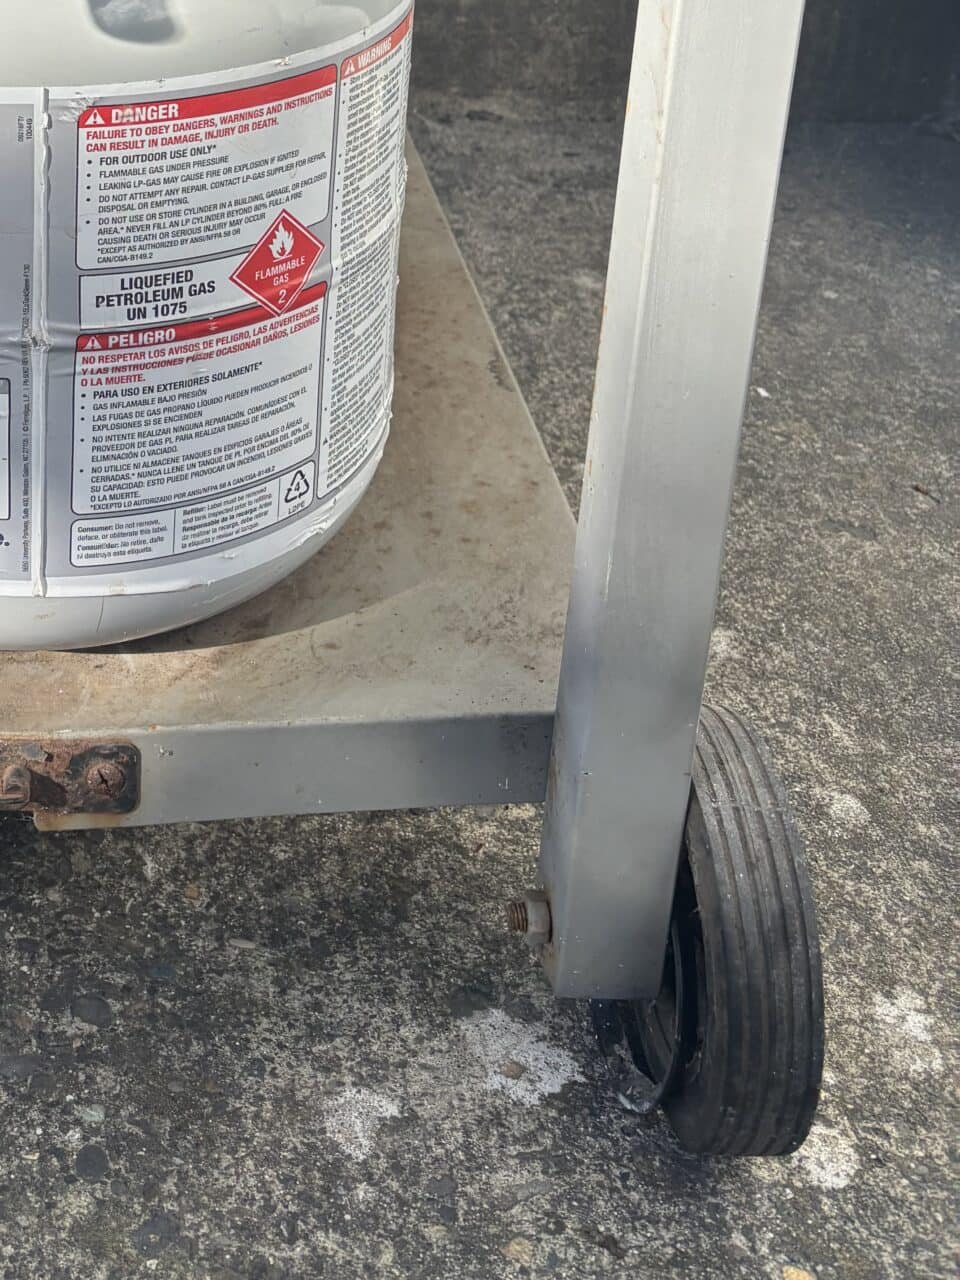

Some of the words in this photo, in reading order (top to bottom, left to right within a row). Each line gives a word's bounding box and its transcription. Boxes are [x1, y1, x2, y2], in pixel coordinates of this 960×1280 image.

[357, 38, 392, 69] WARNING
[86, 129, 127, 140] FAILURE
[131, 128, 142, 137] TO
[145, 125, 169, 135] OBEY
[173, 118, 217, 132] DANGERS,
[220, 109, 264, 125] WARNINGS
[266, 104, 282, 115] AND
[284, 88, 332, 111] INSTRUCTIONS
[112, 104, 178, 123] DANGER
[86, 143, 106, 152] CAN
[110, 140, 145, 151] RESULT
[148, 138, 158, 147] IN
[161, 133, 202, 146] DAMAGE,
[205, 127, 235, 140] INJURY
[238, 124, 249, 134] OR
[252, 117, 279, 131] DEATH.
[100, 156, 119, 166] FOR
[122, 152, 167, 164] OUTDOOR
[170, 150, 187, 160] USE
[100, 167, 146, 178] FLAMMABLE
[149, 165, 164, 175] GAS
[166, 162, 190, 172] UNDER
[193, 156, 229, 168] PRESSURE
[99, 180, 131, 190] LEAKING
[134, 177, 161, 188] LP-GAS
[163, 176, 179, 185] MAY
[181, 172, 204, 182] CAUSE
[206, 169, 221, 178] FIRE
[223, 167, 232, 175] OR
[234, 159, 268, 173] EXPLOSION
[112, 194, 127, 202] NOT
[129, 190, 162, 200] ATTEMPT
[165, 188, 180, 196] ANY
[182, 184, 208, 194] REPAIR.
[210, 177, 240, 189] CONTACT
[242, 172, 265, 183] LP-GAS
[266, 163, 294, 176] SUPPLIER
[295, 159, 306, 167] FOR
[98, 204, 136, 213] DISPOSAL
[138, 202, 148, 210] OR
[99, 217, 109, 225] DO
[112, 216, 127, 224] NOT
[129, 214, 144, 222] USE
[146, 213, 156, 221] OR
[159, 210, 181, 219] STORE
[184, 204, 217, 216] CYLINDER
[220, 202, 226, 210] IN
[292, 183, 300, 191] OR
[126, 224, 150, 233] NEVER
[153, 221, 166, 230] FILL
[169, 219, 179, 227] AN
[181, 218, 190, 226] LP
[192, 212, 225, 224] CYLINDER
[227, 206, 252, 217] BEYOND
[98, 236, 131, 245] CAUSING
[133, 233, 157, 242] DEATH
[159, 231, 169, 239] OR
[171, 226, 201, 238] SERIOUS
[204, 222, 226, 232] INJURY
[229, 218, 242, 227] MAY
[138, 238, 178, 251] AUTHORIZED
[180, 237, 188, 245] BY
[256, 256, 305, 280] FLAMMABLE
[120, 270, 193, 290] LIQUEFIED
[273, 274, 288, 286] GAS
[96, 287, 183, 308] PETROLEUM
[188, 280, 215, 296] GAS
[278, 289, 286, 304] 2
[127, 307, 146, 320] UN
[152, 301, 187, 317] 1075
[82, 356, 95, 365] NO
[98, 352, 145, 364] RESPETAR
[149, 349, 165, 358] LOS
[168, 343, 200, 356] AVISOS
[203, 340, 214, 349] DE
[216, 331, 251, 346] PELIGRO,
[253, 325, 267, 337] LAS
[269, 304, 319, 331] ADVERTENCIAS
[91, 367, 108, 375] LAS
[112, 358, 184, 372] INSTRUCCIONES
[216, 340, 261, 356] OCASIONAR
[290, 314, 320, 333] LESIONES
[108, 328, 176, 348] PELIGRO
[90, 377, 102, 386] LA
[106, 374, 145, 384] MUERTE.
[93, 390, 118, 399] PARA
[121, 387, 139, 397] USO
[142, 386, 154, 394] EN
[157, 376, 209, 393] EXTERIORES
[93, 414, 106, 422] LAS
[109, 411, 133, 420] FUGAS
[135, 410, 144, 418] DE
[147, 407, 161, 416] GAS
[163, 402, 195, 413] PROPANO
[225, 389, 249, 400] PUEDEN
[110, 397, 155, 409] INFLAMABLE
[157, 395, 176, 404] BAJO
[178, 389, 207, 400] PRESIÓN
[92, 420, 142, 431] EXPLOSIONES
[164, 411, 202, 424] ENCIENDEN
[92, 435, 103, 443] NO
[105, 432, 135, 442] INTENTE
[137, 427, 171, 439] REALIZAR
[173, 421, 203, 433] NINGUNA
[92, 442, 135, 453] PROVEEDOR
[137, 440, 147, 448] DE
[149, 439, 163, 447] GAS
[175, 434, 192, 442] PARA
[195, 426, 225, 439] REALIZAR
[104, 463, 131, 472] UTILICE
[142, 456, 179, 468] ALMACENE
[91, 485, 100, 493] SU
[295, 482, 300, 491] 4
[97, 494, 107, 502] LA
